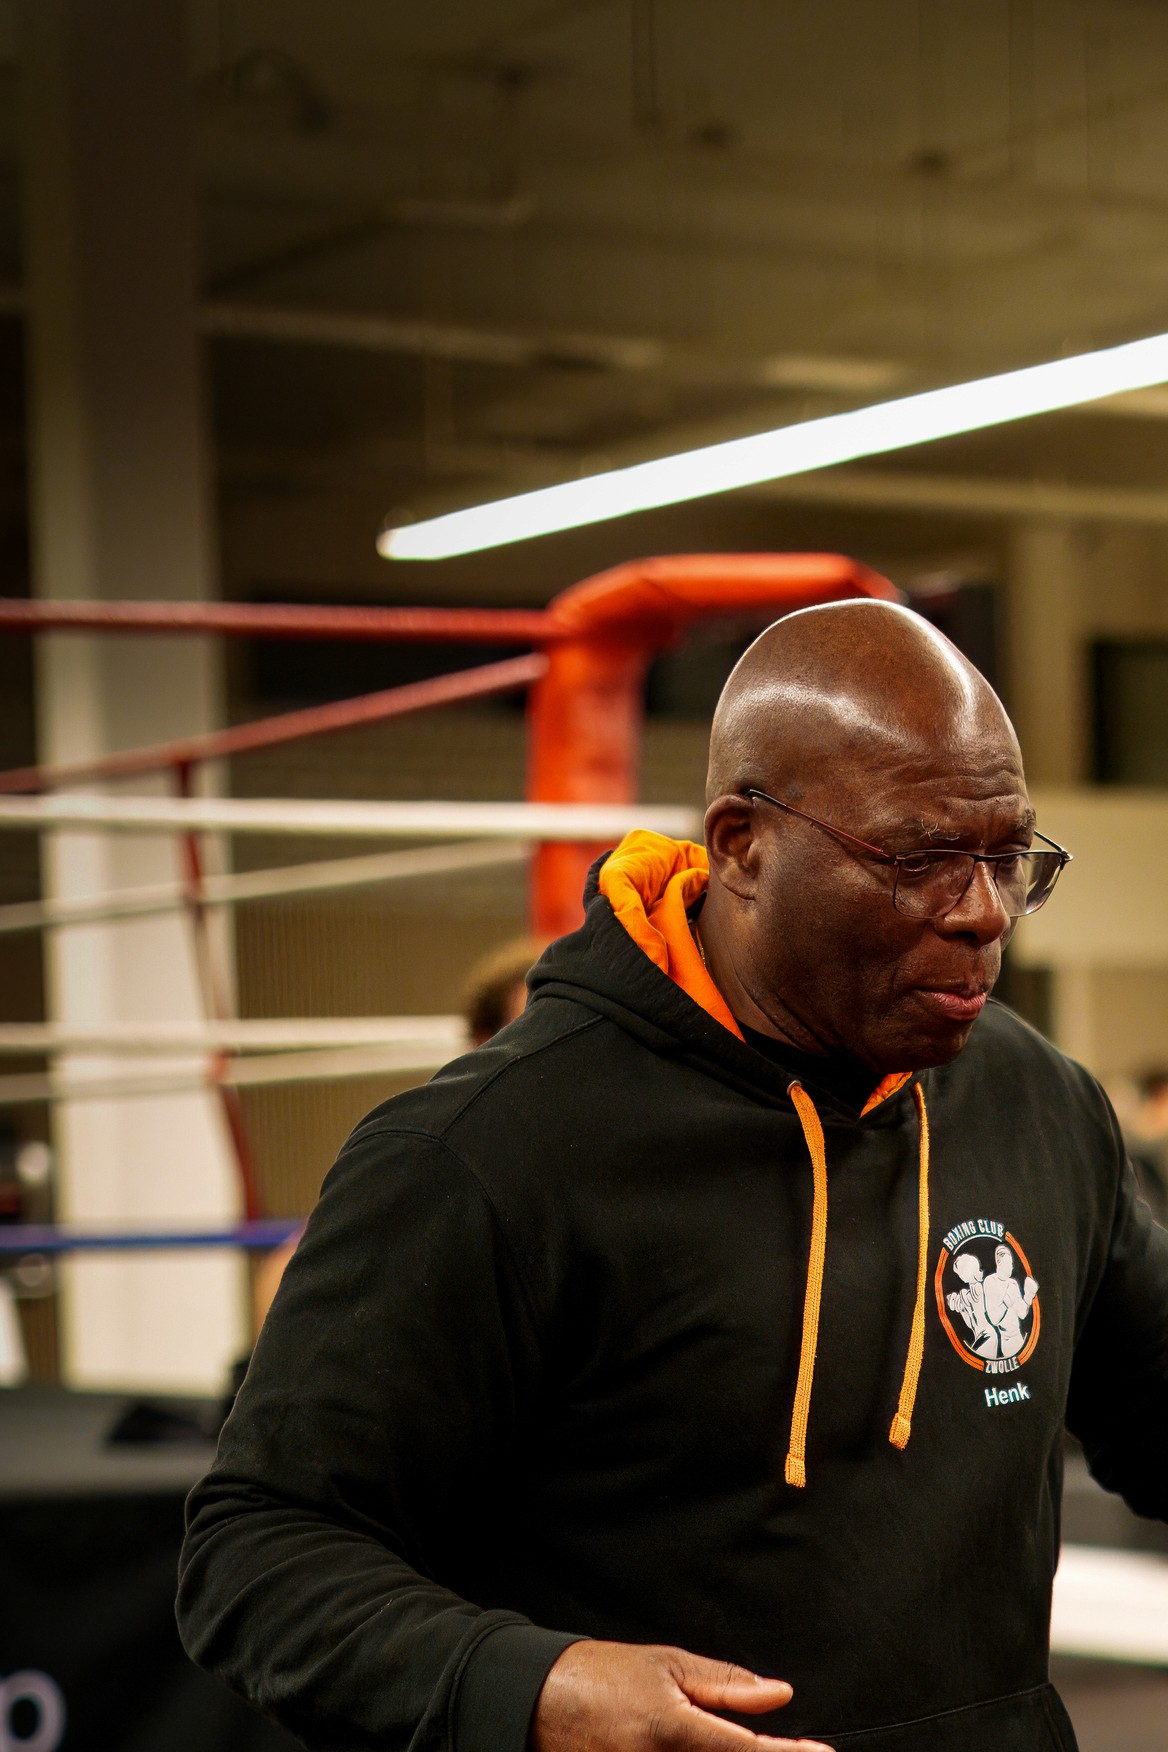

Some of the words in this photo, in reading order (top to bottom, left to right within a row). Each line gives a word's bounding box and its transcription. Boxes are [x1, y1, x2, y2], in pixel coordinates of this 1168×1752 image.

[943, 1220, 976, 1251] BOXING
[977, 1219, 1004, 1237] CLUB
[985, 1359, 1019, 1374] ZWOLLE
[984, 1382, 1030, 1407] Henk
